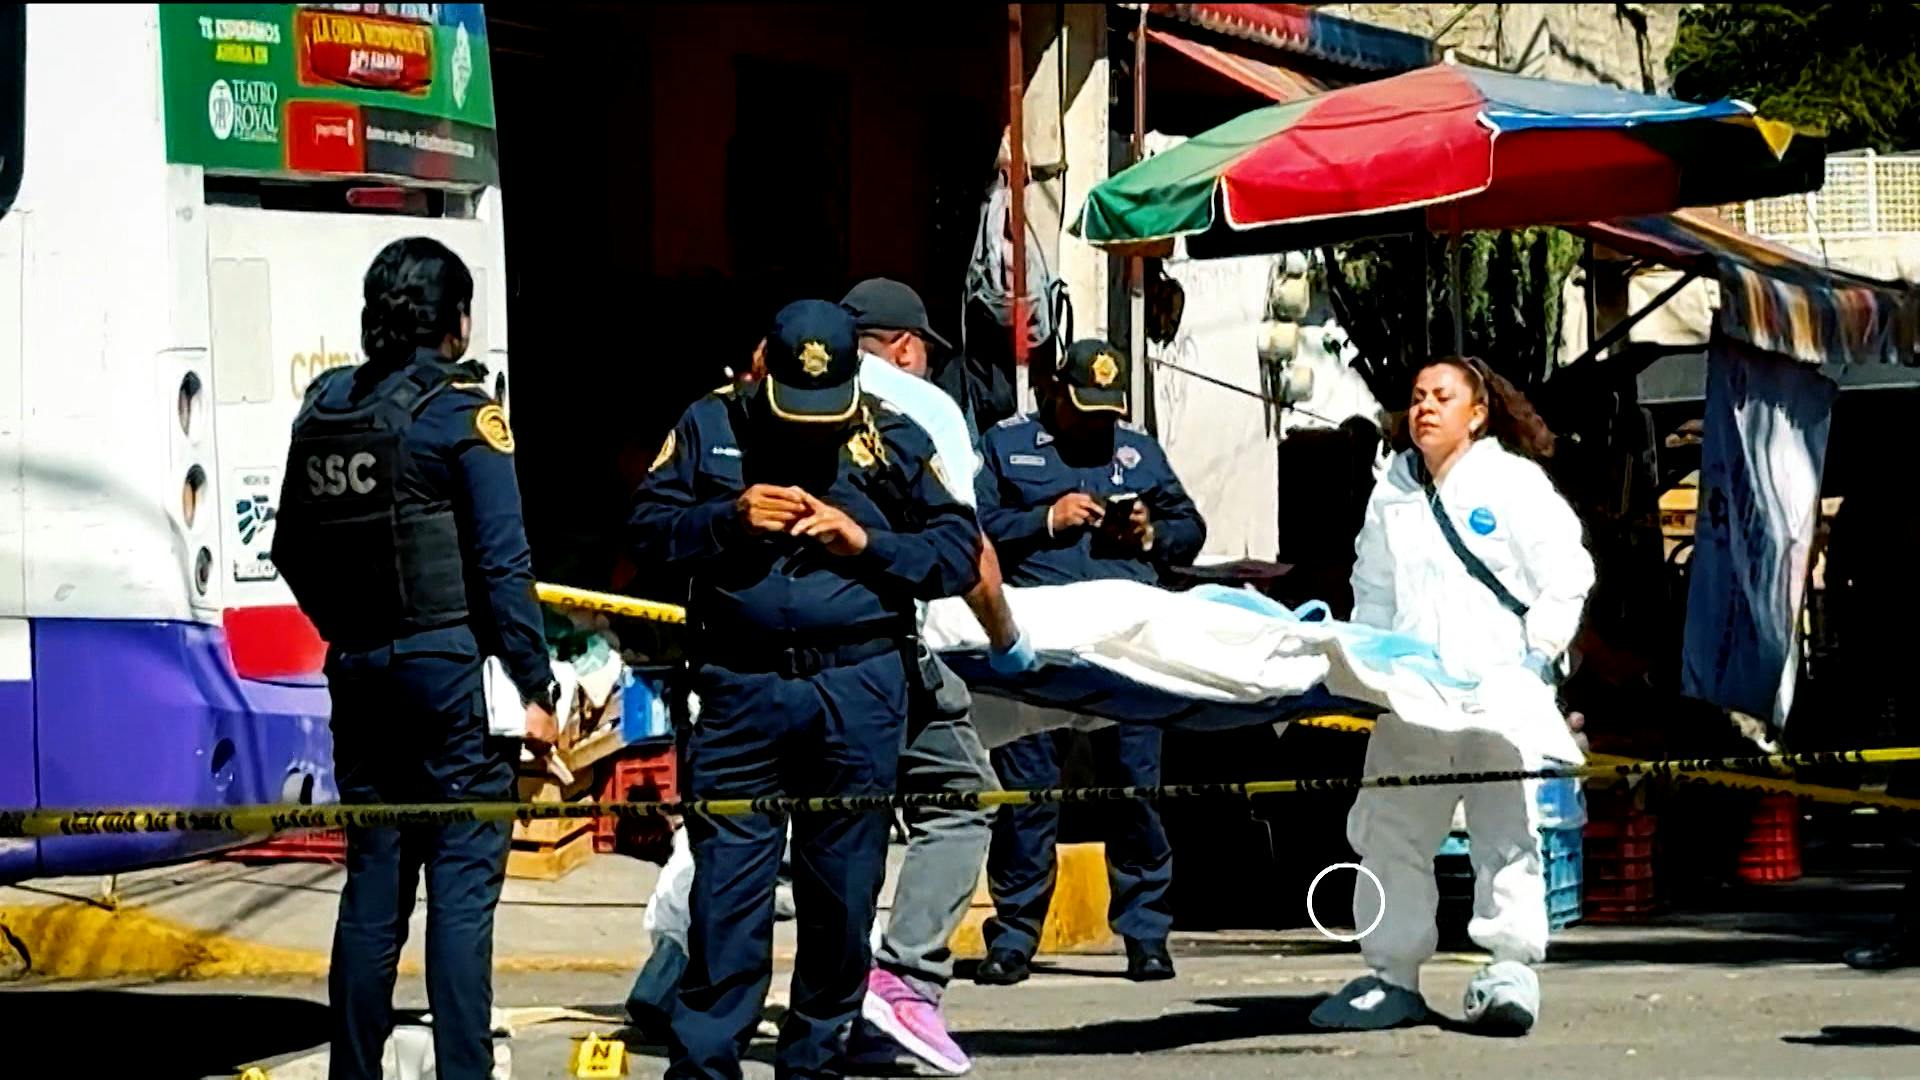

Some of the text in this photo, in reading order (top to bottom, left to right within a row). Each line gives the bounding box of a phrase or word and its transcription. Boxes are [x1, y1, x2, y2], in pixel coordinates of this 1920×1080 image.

[232, 79, 277, 105] TEATRO
[234, 103, 277, 138] ROYAL
[305, 451, 377, 496] SSC
